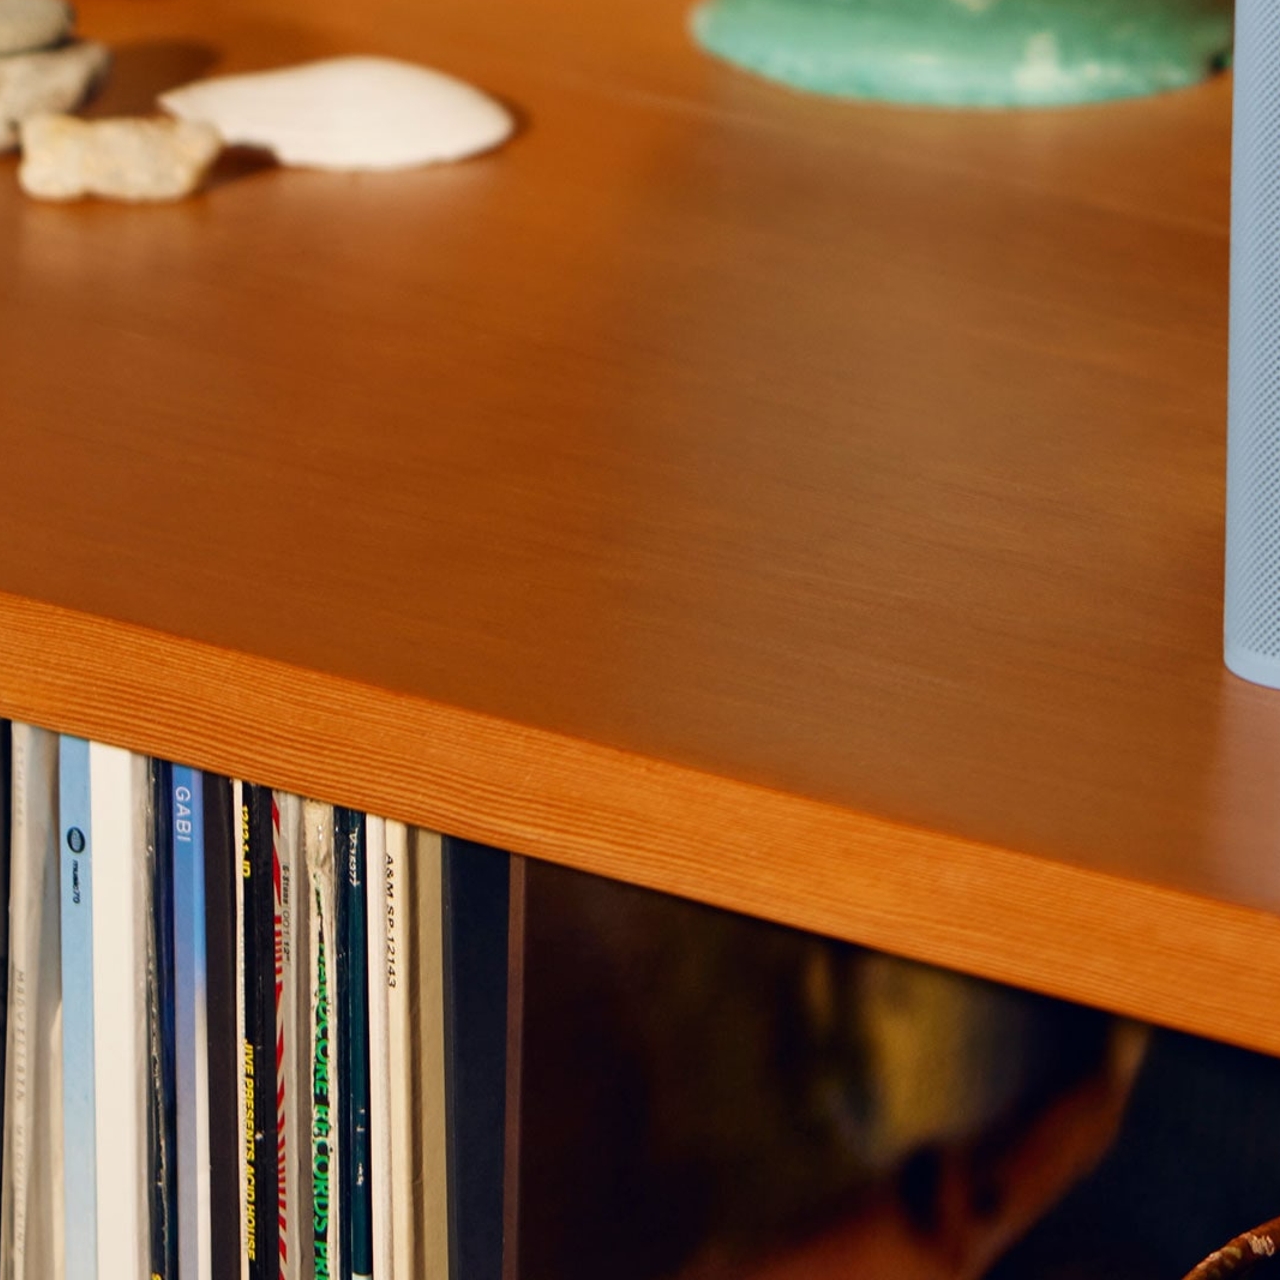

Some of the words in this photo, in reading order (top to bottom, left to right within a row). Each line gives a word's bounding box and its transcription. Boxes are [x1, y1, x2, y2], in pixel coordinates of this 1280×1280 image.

[174, 785, 191, 842] GABI
[384, 852, 396, 898] A&M
[386, 902, 398, 988] SP-12143
[243, 1040, 254, 1075] JIVE
[244, 1076, 255, 1160] PRESENTS
[246, 1161, 256, 1202] ACID
[314, 1102, 332, 1233] RECORDS
[246, 1202, 257, 1261] HOUSE
